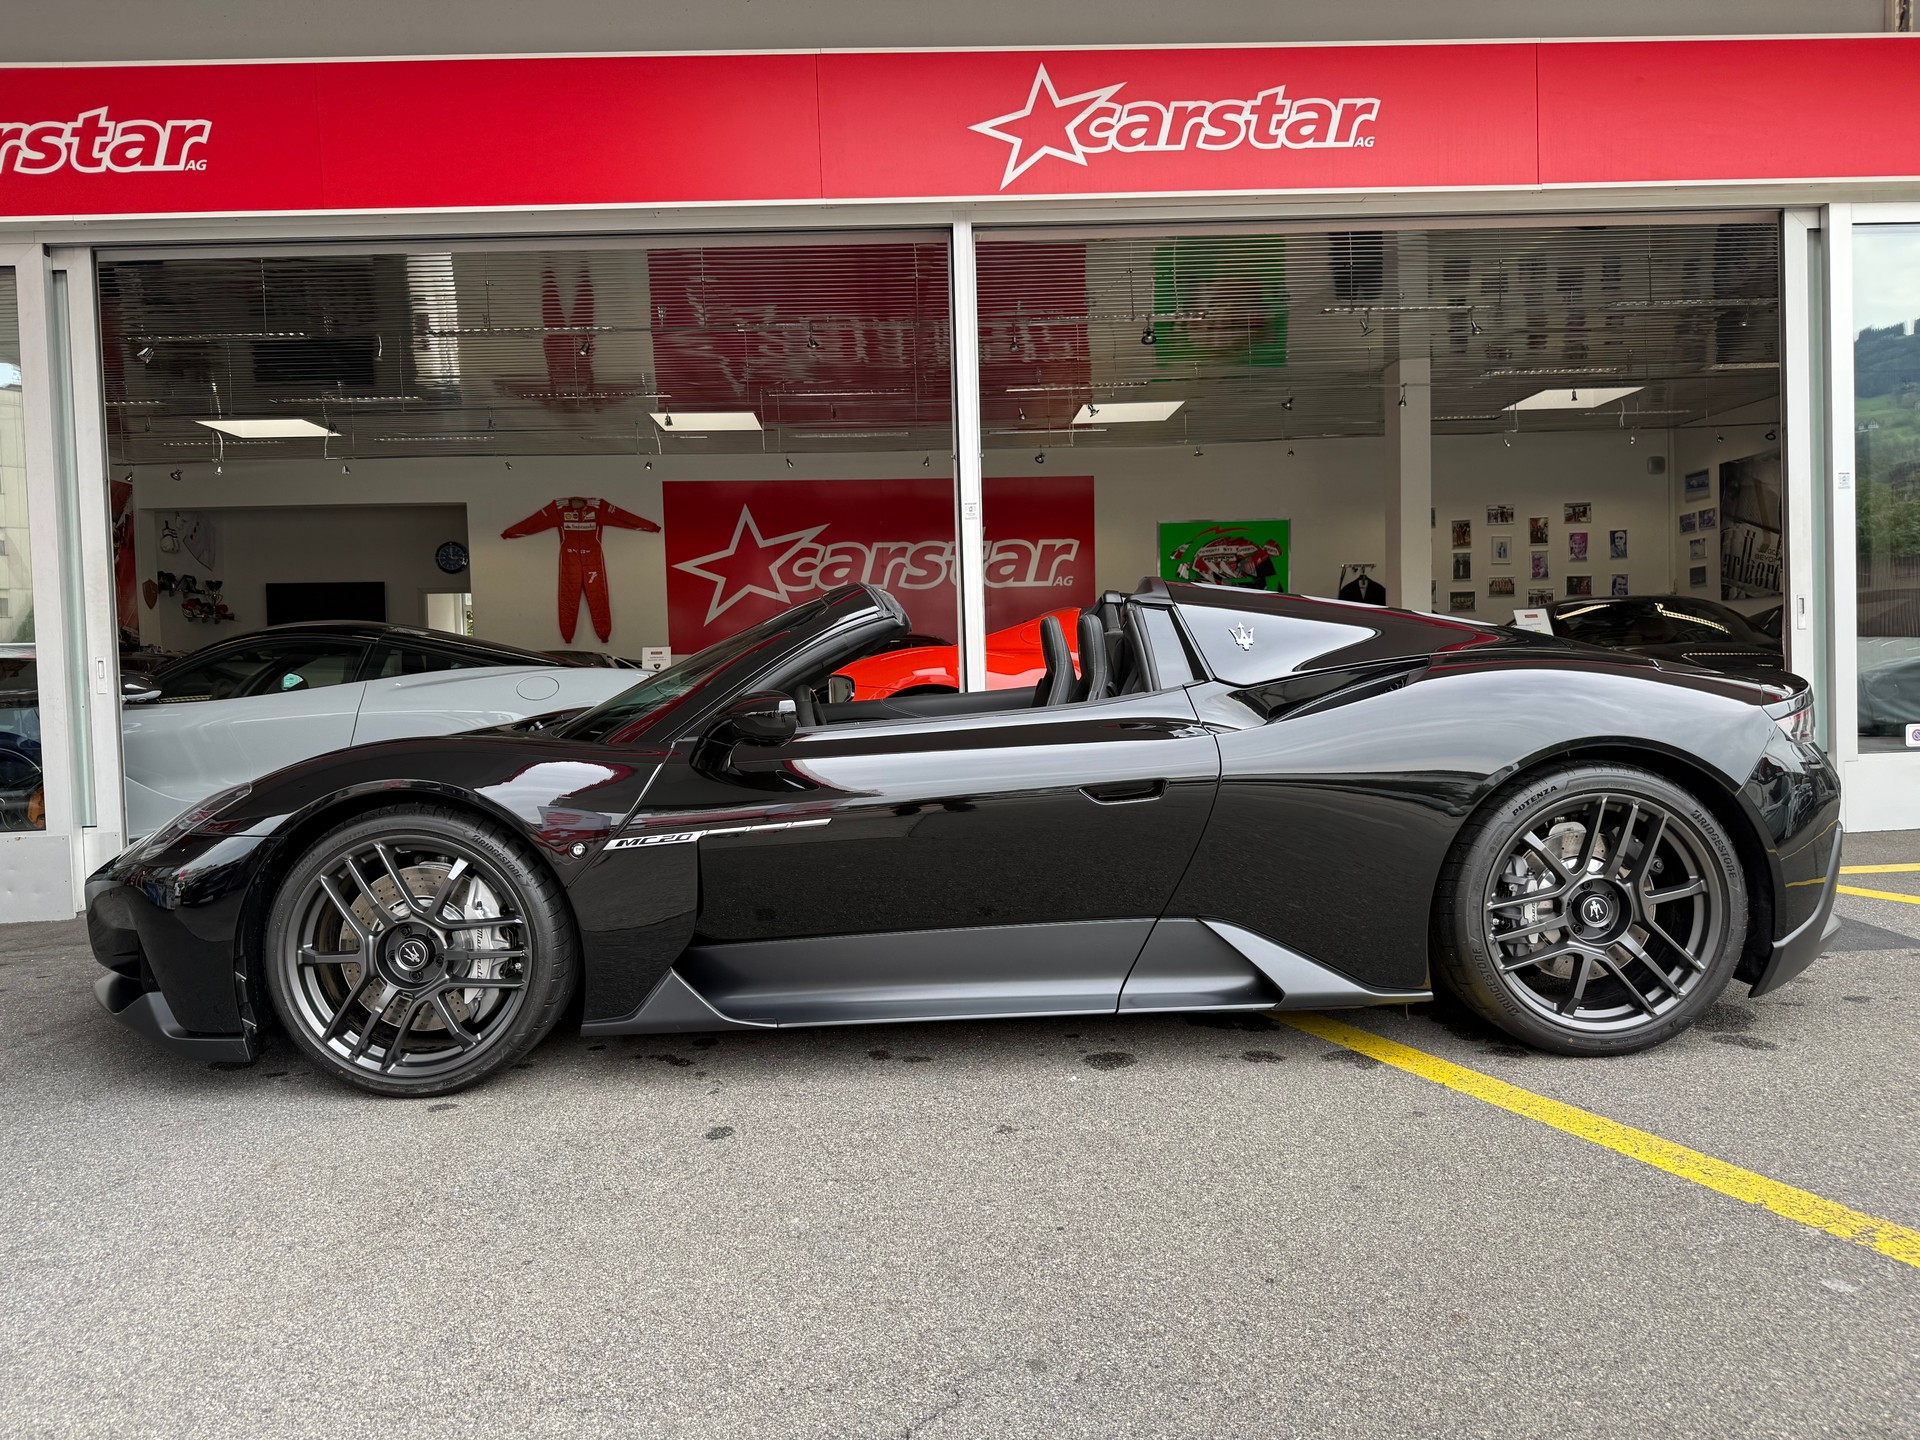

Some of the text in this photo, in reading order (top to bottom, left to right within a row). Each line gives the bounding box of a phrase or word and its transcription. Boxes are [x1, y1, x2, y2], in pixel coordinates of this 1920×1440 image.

[1073, 84, 1381, 153] carstar AG
[185, 159, 208, 171] AG
[588, 571, 598, 584] 7
[777, 528, 1080, 591] carsar AG
[1512, 785, 1558, 816] POTENZA
[471, 834, 523, 879] BRIDGESTONE
[614, 831, 694, 848] MC20
[1691, 809, 1737, 878] BRIDGESTONE
[1472, 948, 1521, 1016] BRIDGESTONE
